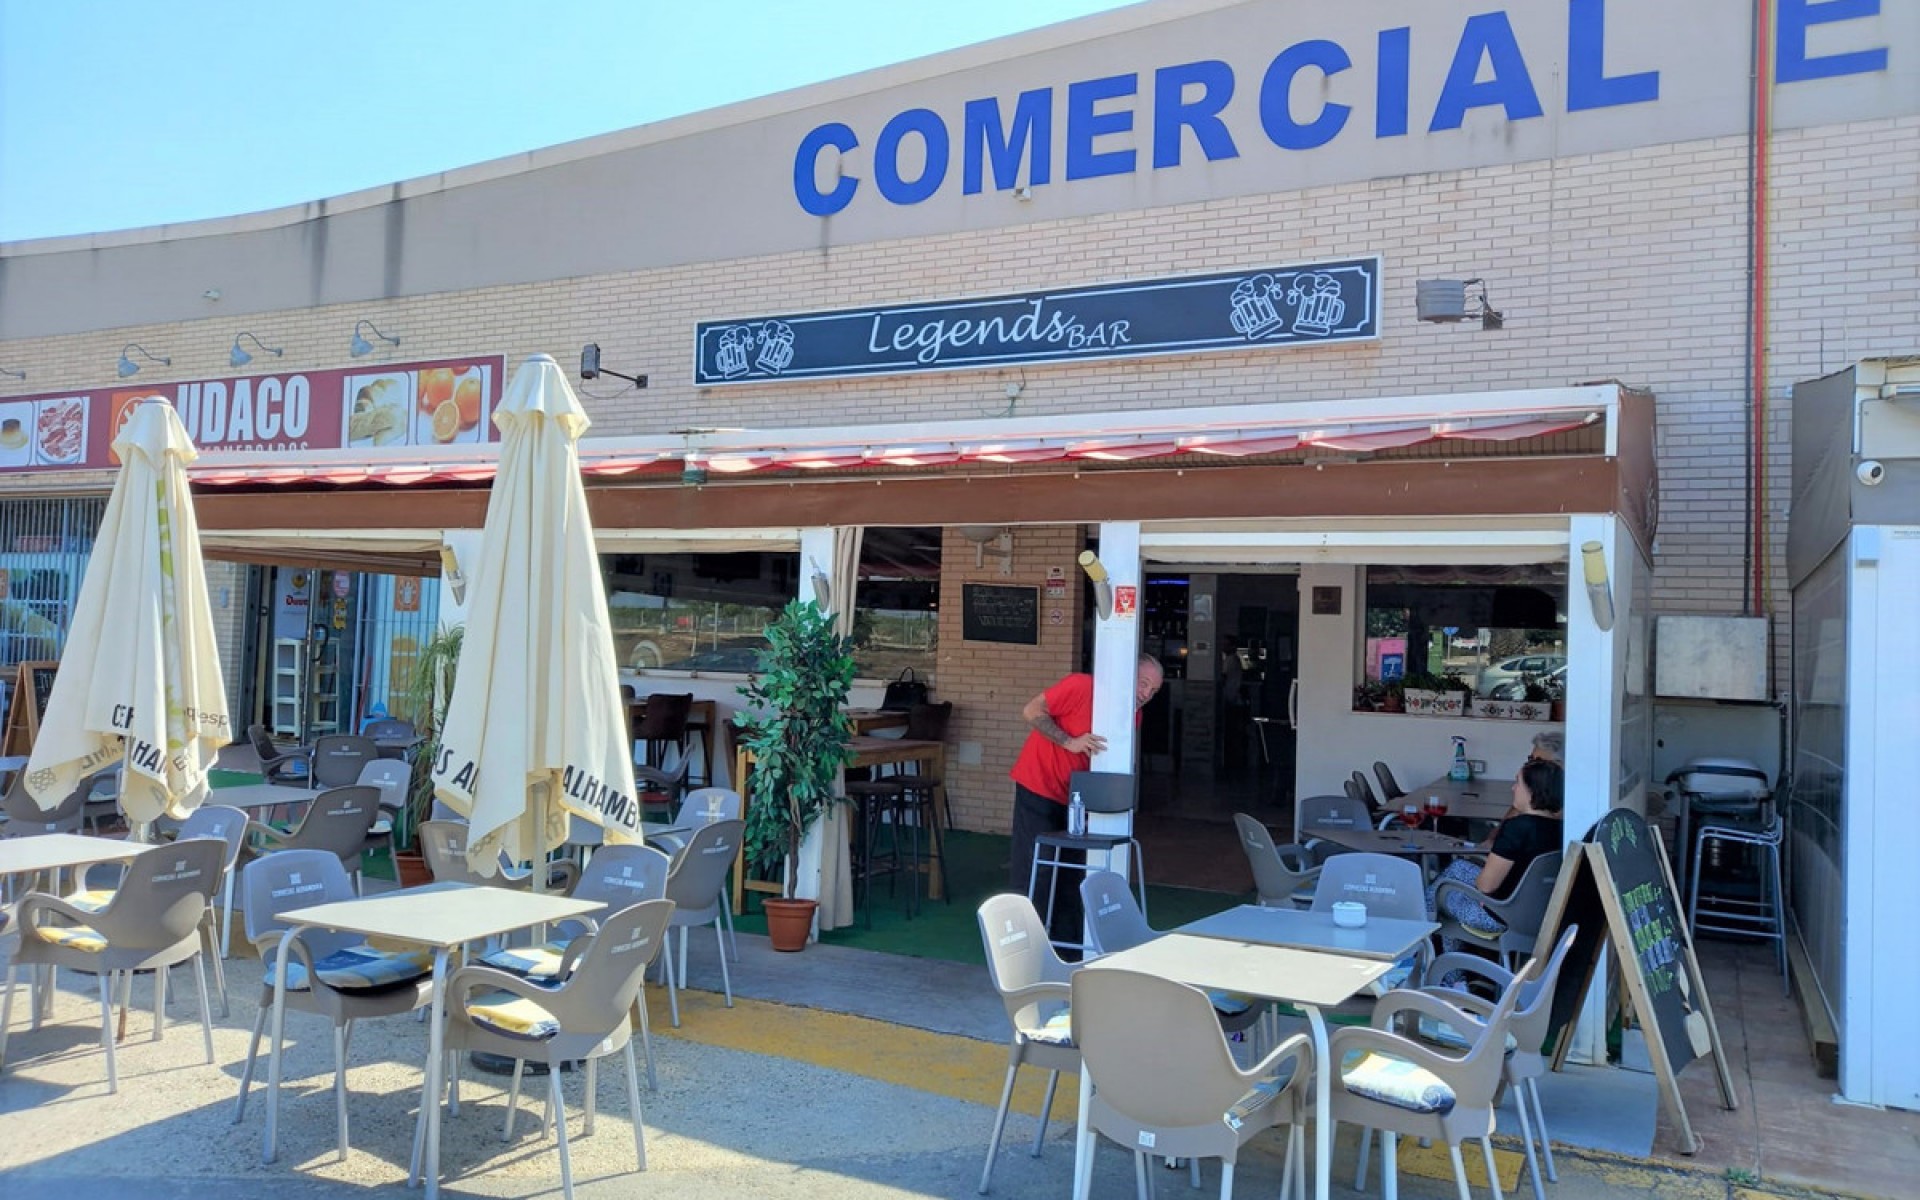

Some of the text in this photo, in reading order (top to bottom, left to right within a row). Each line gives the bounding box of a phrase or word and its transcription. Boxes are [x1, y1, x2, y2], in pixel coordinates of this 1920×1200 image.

[794, 0, 1659, 217] COMERCIAL
[868, 299, 1131, 363] Legends BAR
[176, 375, 310, 443] UDACO
